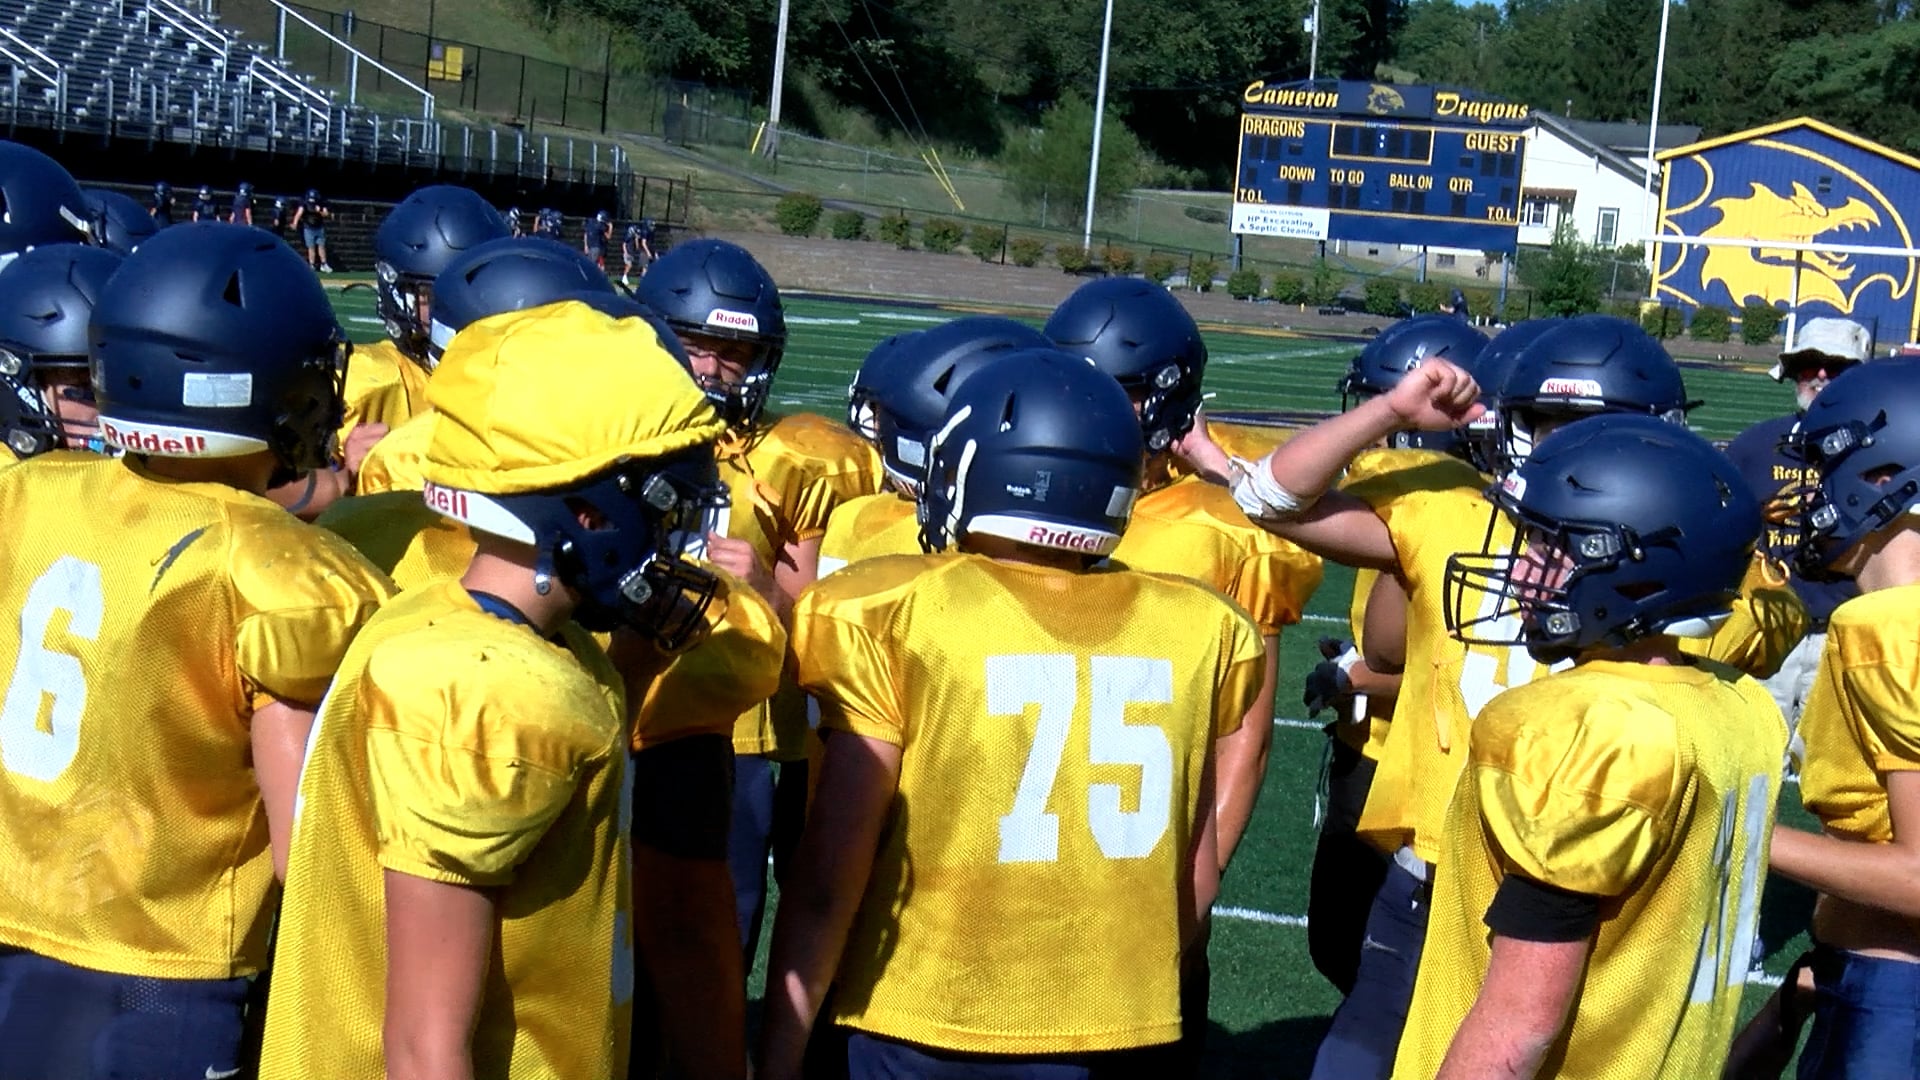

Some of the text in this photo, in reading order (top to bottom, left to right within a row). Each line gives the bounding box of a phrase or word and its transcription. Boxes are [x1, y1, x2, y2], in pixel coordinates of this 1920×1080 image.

[1244, 80, 1339, 108] Cameron
[1436, 91, 1529, 123] Dragons
[1245, 118, 1305, 138] DRAGONS
[1465, 132, 1519, 152] GUEST
[1280, 164, 1316, 182] DOWN
[1330, 168, 1365, 185] TO GO
[1389, 172, 1433, 190] BALL ON
[1449, 176, 1473, 193] QTR
[1239, 188, 1267, 203] T.O.L.
[1263, 216, 1313, 228] Excavating
[1487, 205, 1516, 221] T.O.L.
[1249, 223, 1277, 232] Septic
[1280, 226, 1320, 237] Cleaning
[716, 312, 754, 326] Riddell
[104, 423, 206, 454] Riddell
[1029, 526, 1110, 553] Riddell
[0, 554, 105, 783] 6
[985, 652, 1174, 865] 75
